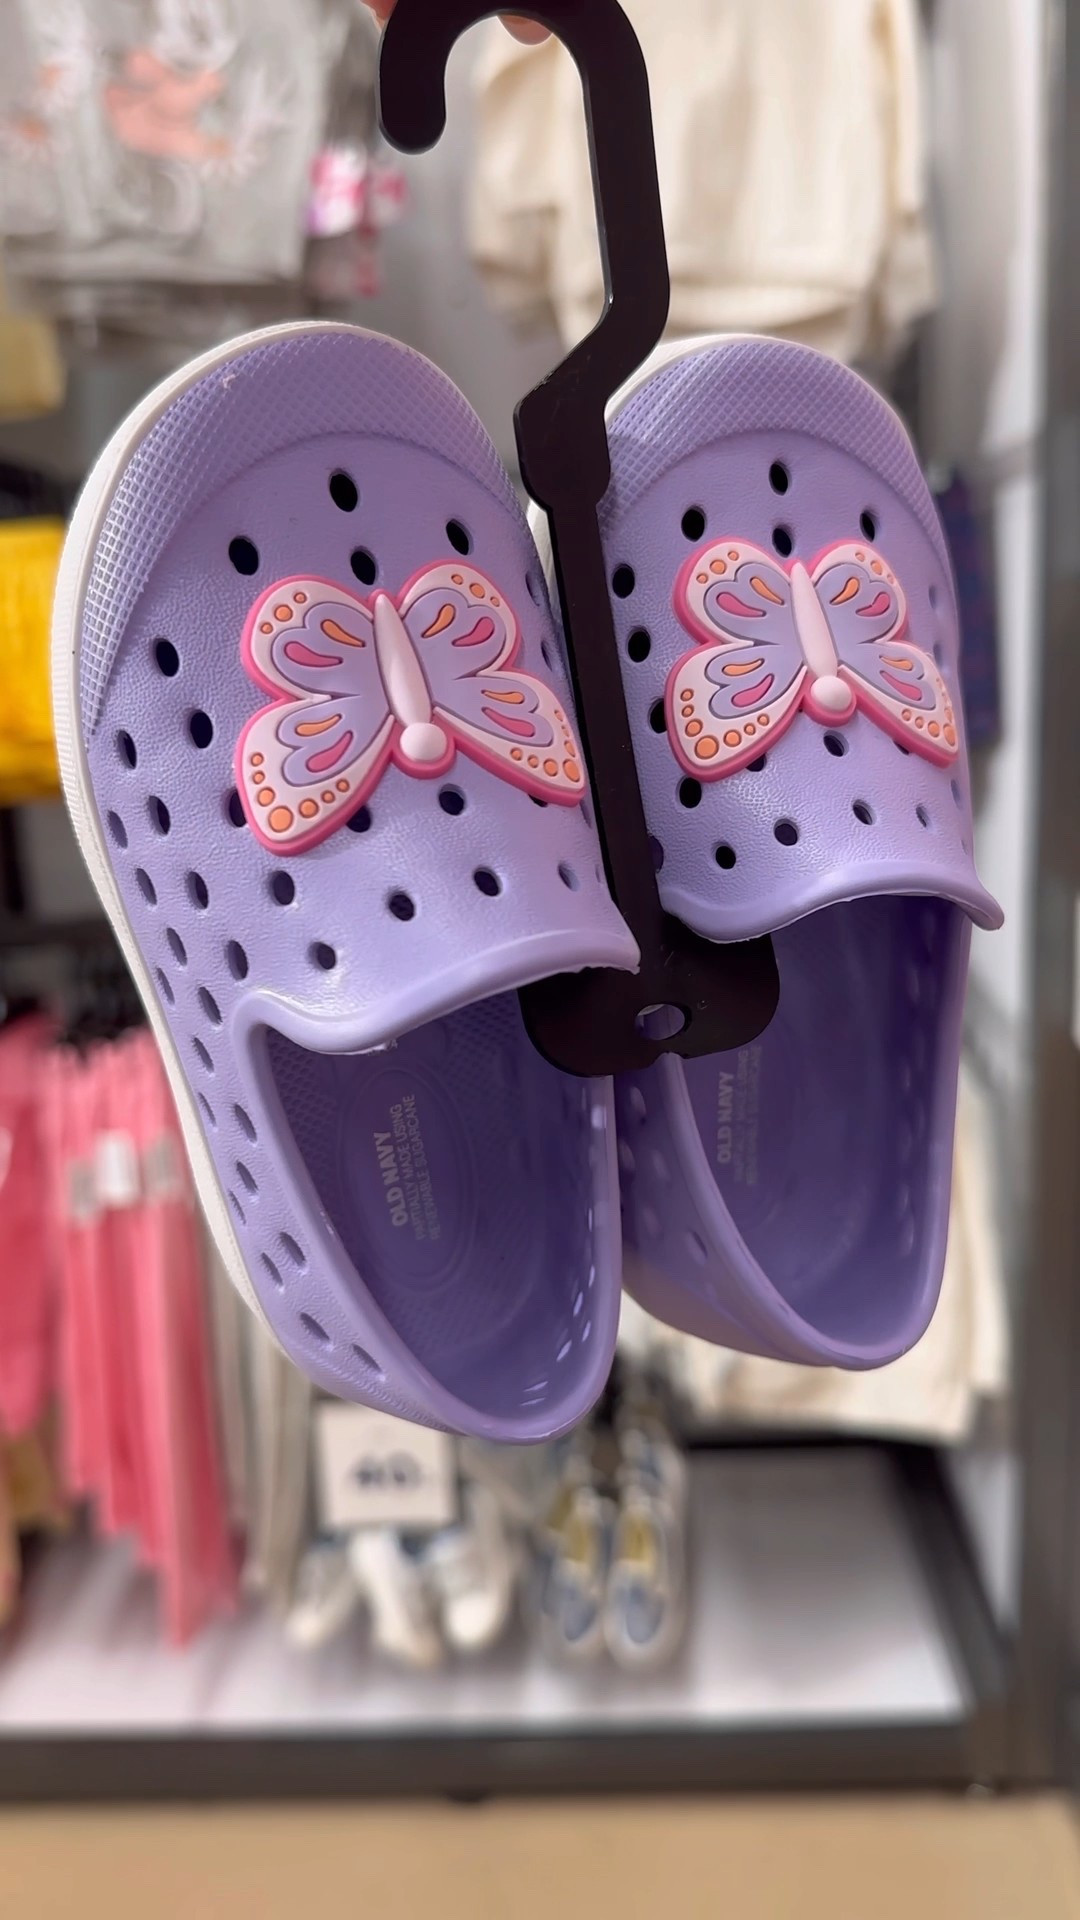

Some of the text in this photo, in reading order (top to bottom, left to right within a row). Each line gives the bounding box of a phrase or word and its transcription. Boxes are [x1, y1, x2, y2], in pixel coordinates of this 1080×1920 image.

[390, 1103, 407, 1142] USING
[403, 1094, 427, 1167] SUGARCANE
[717, 1071, 734, 1163] OLD NAVY
[374, 1132, 408, 1226] OLD NAVY
[398, 1143, 414, 1179] MADE
